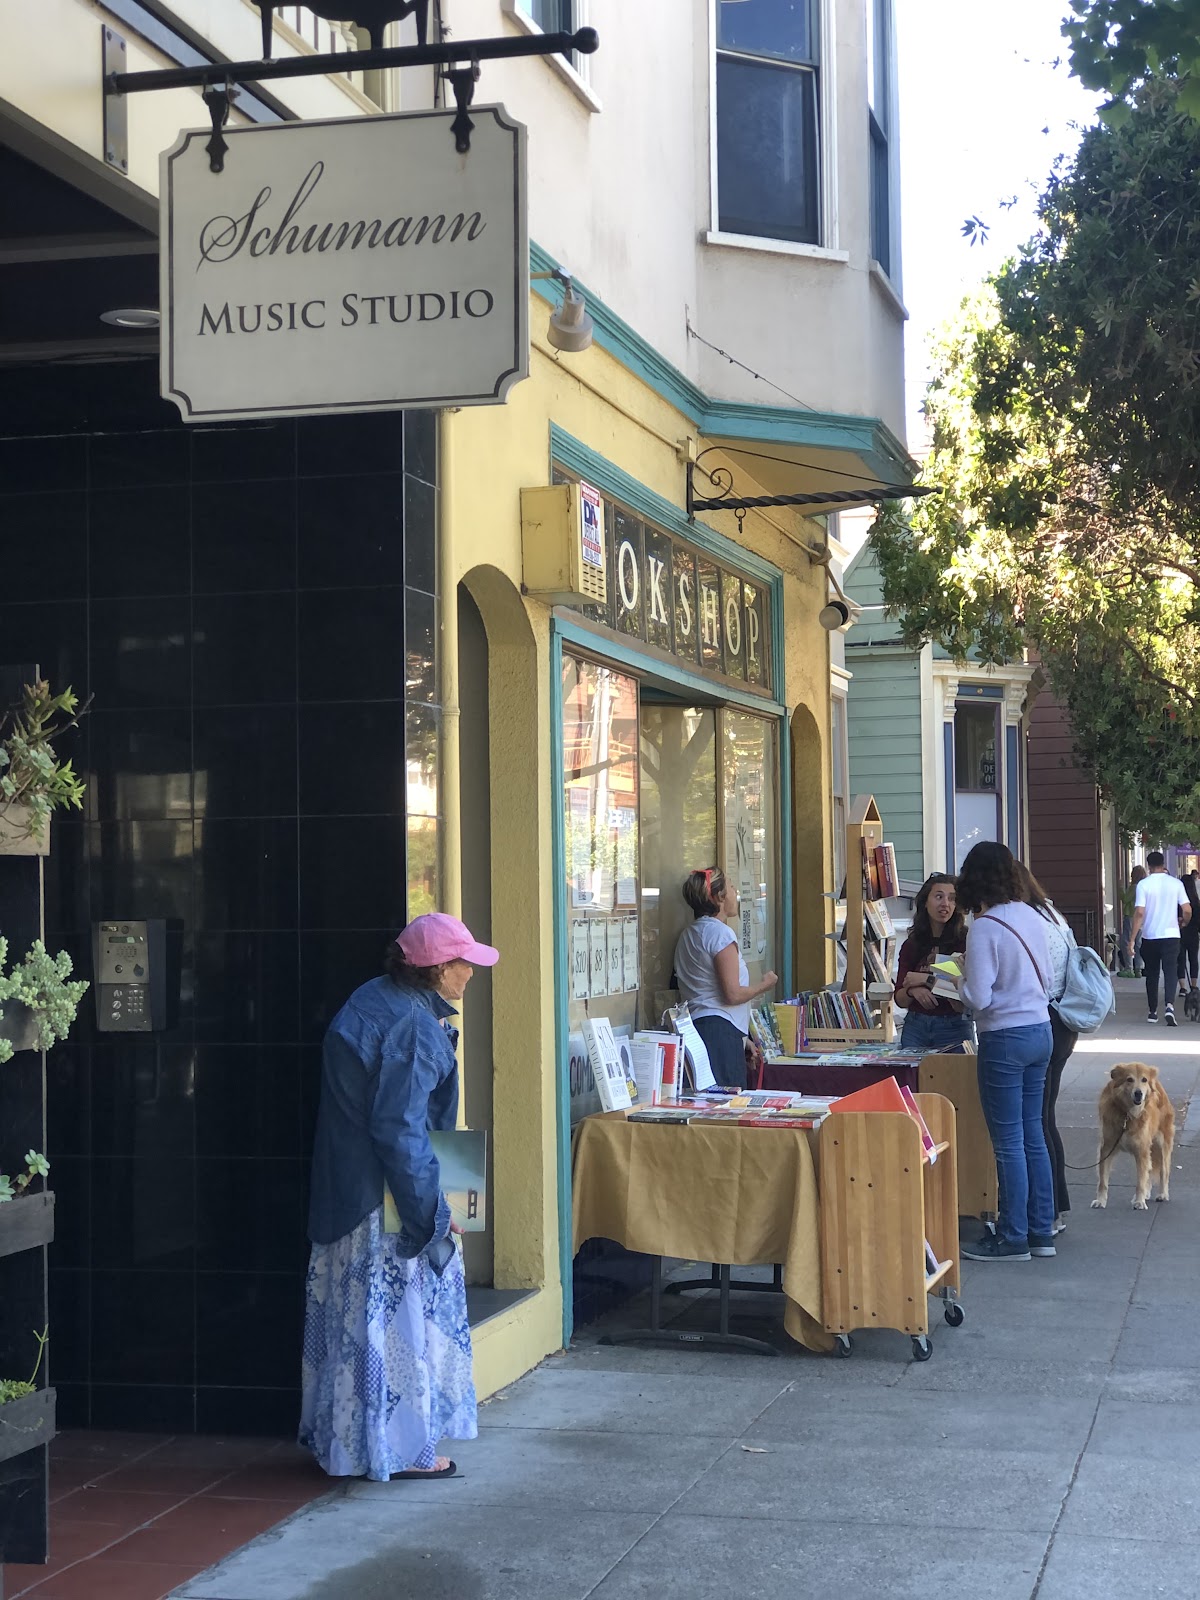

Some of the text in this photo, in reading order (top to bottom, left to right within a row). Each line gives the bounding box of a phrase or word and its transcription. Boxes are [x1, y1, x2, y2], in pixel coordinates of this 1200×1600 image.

[195, 160, 487, 274] Schumann
[196, 288, 495, 336] MUSIC STUDIO
[618, 540, 759, 662] OKSHOP
